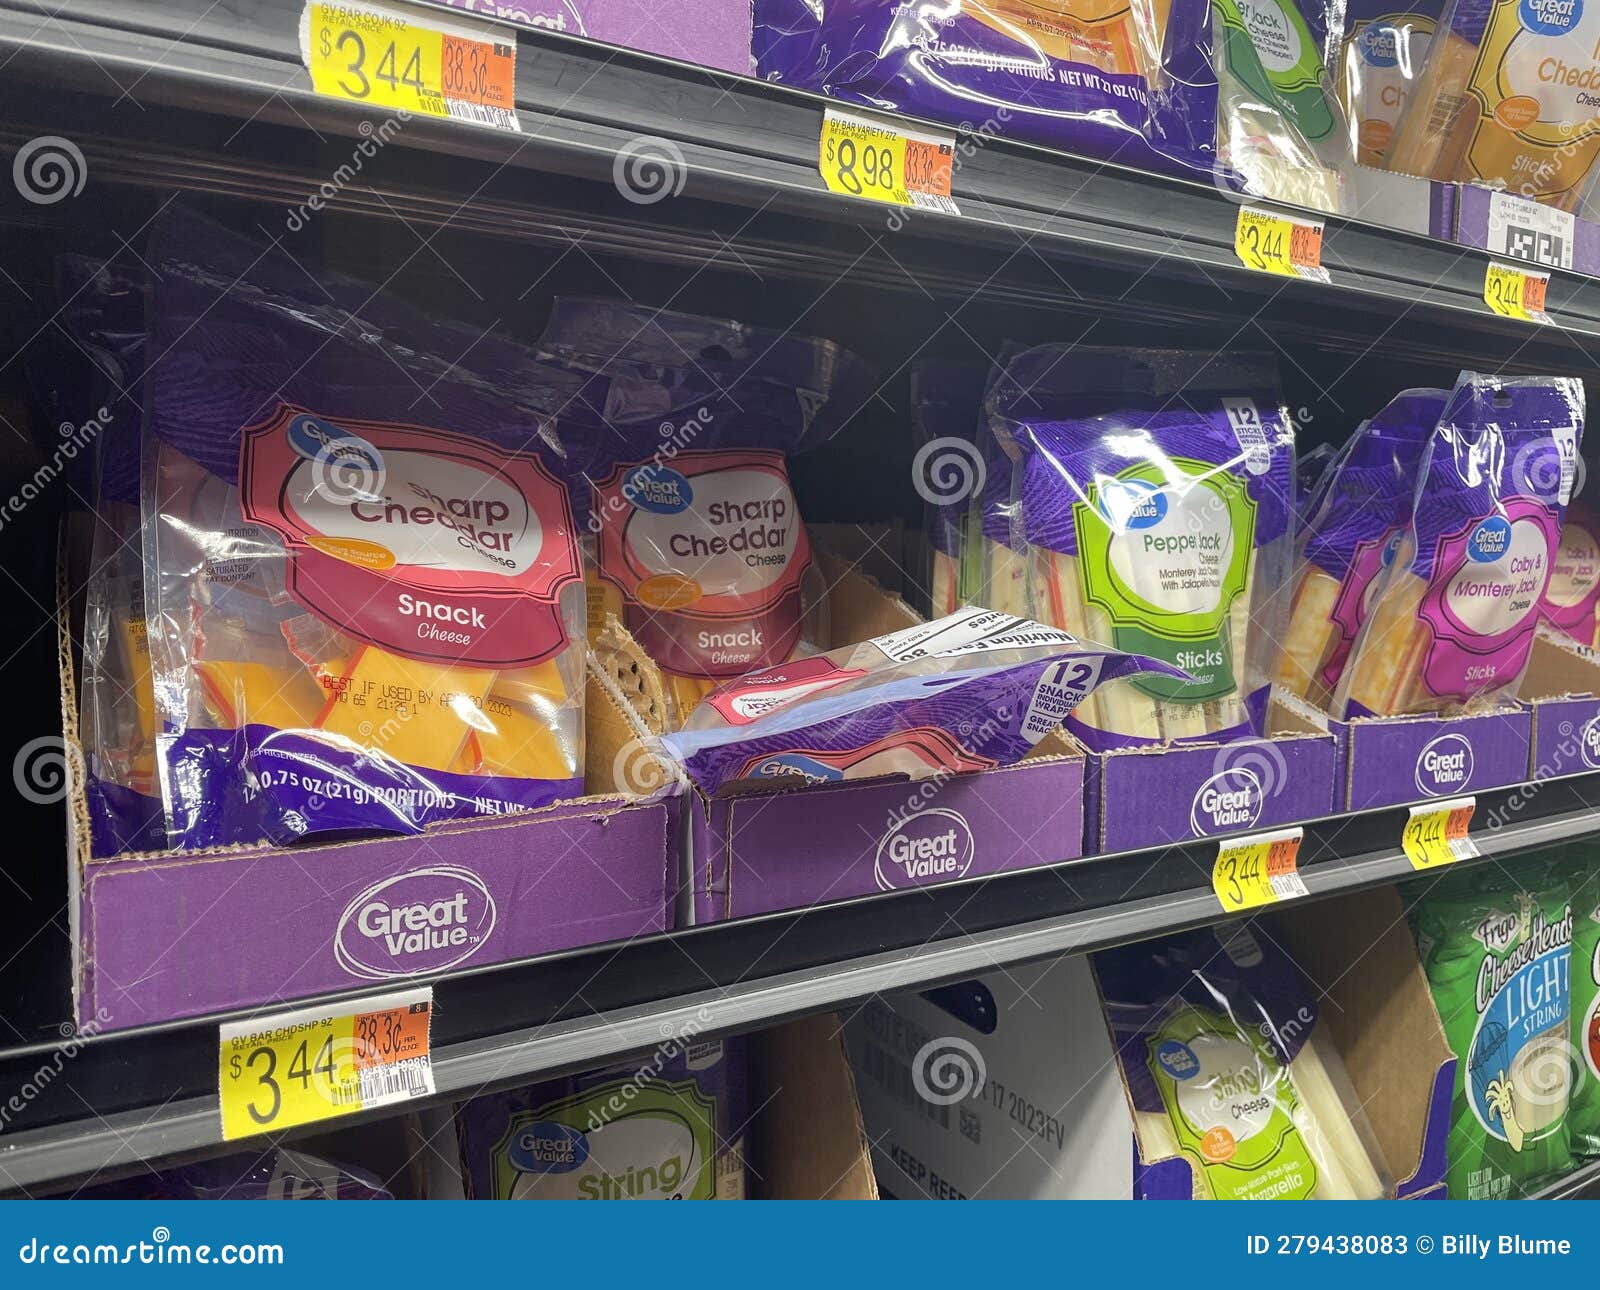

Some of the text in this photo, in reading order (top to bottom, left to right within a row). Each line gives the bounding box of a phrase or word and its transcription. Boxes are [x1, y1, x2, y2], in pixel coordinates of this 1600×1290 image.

[320, 3, 336, 17] GV
[339, 7, 361, 21] BAR
[394, 18, 406, 32] 9Z
[321, 15, 382, 33] RETAIL PRICE
[1536, 10, 1570, 26] Value
[1366, 32, 1396, 48] Grea
[1372, 46, 1397, 58] Valu
[1059, 69, 1081, 86] NET
[1082, 73, 1100, 89] WT
[830, 118, 841, 128] GV
[842, 120, 855, 132] BAR
[857, 123, 884, 139] VARIETY
[1229, 407, 1257, 425] 12
[408, 481, 511, 531] Sharp
[643, 491, 681, 506] Value
[708, 498, 786, 525] Sharp
[1128, 501, 1157, 518] alue
[350, 497, 514, 553] Cheddar
[1475, 527, 1506, 544] Great
[669, 525, 786, 557] Cheddar
[1198, 531, 1221, 550] Jack
[1479, 541, 1504, 553] Value
[457, 536, 517, 569] Cheese
[745, 553, 786, 567] Cheese
[206, 564, 249, 577] SATURATED
[1160, 568, 1197, 579] Monterey
[1511, 554, 1541, 575] Colby &
[1161, 580, 1179, 591] With
[1454, 577, 1538, 598] Monterey Jack
[397, 595, 487, 630] Snack
[1509, 599, 1531, 611] Cheese
[417, 622, 471, 645] Cheese
[698, 629, 763, 649] Snack
[989, 631, 1074, 647] Nutrition
[711, 651, 751, 664] Cheese
[1176, 649, 1223, 670] Sticks
[1053, 661, 1093, 691] 12
[1464, 665, 1497, 681] Sticks
[324, 675, 353, 691] BEST
[363, 681, 376, 694] IF
[382, 685, 412, 702] USED
[418, 690, 434, 705] BY
[440, 692, 458, 708] AP
[1037, 693, 1078, 708] INDIVIDUAL
[1038, 684, 1088, 703] SNACKS
[1026, 723, 1051, 734] SNAC
[1029, 715, 1057, 728] GREAT
[1424, 749, 1465, 771] Great
[1433, 767, 1463, 783] Value
[260, 770, 299, 789] 0.75
[326, 780, 370, 805] (21g)
[374, 785, 456, 809] PORTIONS
[474, 796, 502, 815] NET
[1202, 785, 1251, 813] Great
[1213, 807, 1249, 827] Value
[888, 828, 957, 863] Great
[905, 856, 957, 879] Value
[357, 893, 468, 938] Great
[384, 926, 468, 956] Value
[1477, 913, 1519, 948] Frigo
[1505, 951, 1571, 1031] LIGHT
[1523, 999, 1562, 1039] STRING
[231, 1017, 334, 1046] GV BAR CHDSHP 9Z
[990, 1080, 1065, 1150] 17 2023FV
[1231, 1097, 1270, 1119] Cheese
[519, 1133, 574, 1152] Great
[533, 1149, 576, 1163] Value
[890, 1143, 926, 1183] KEEP
[577, 1155, 681, 1200] String
